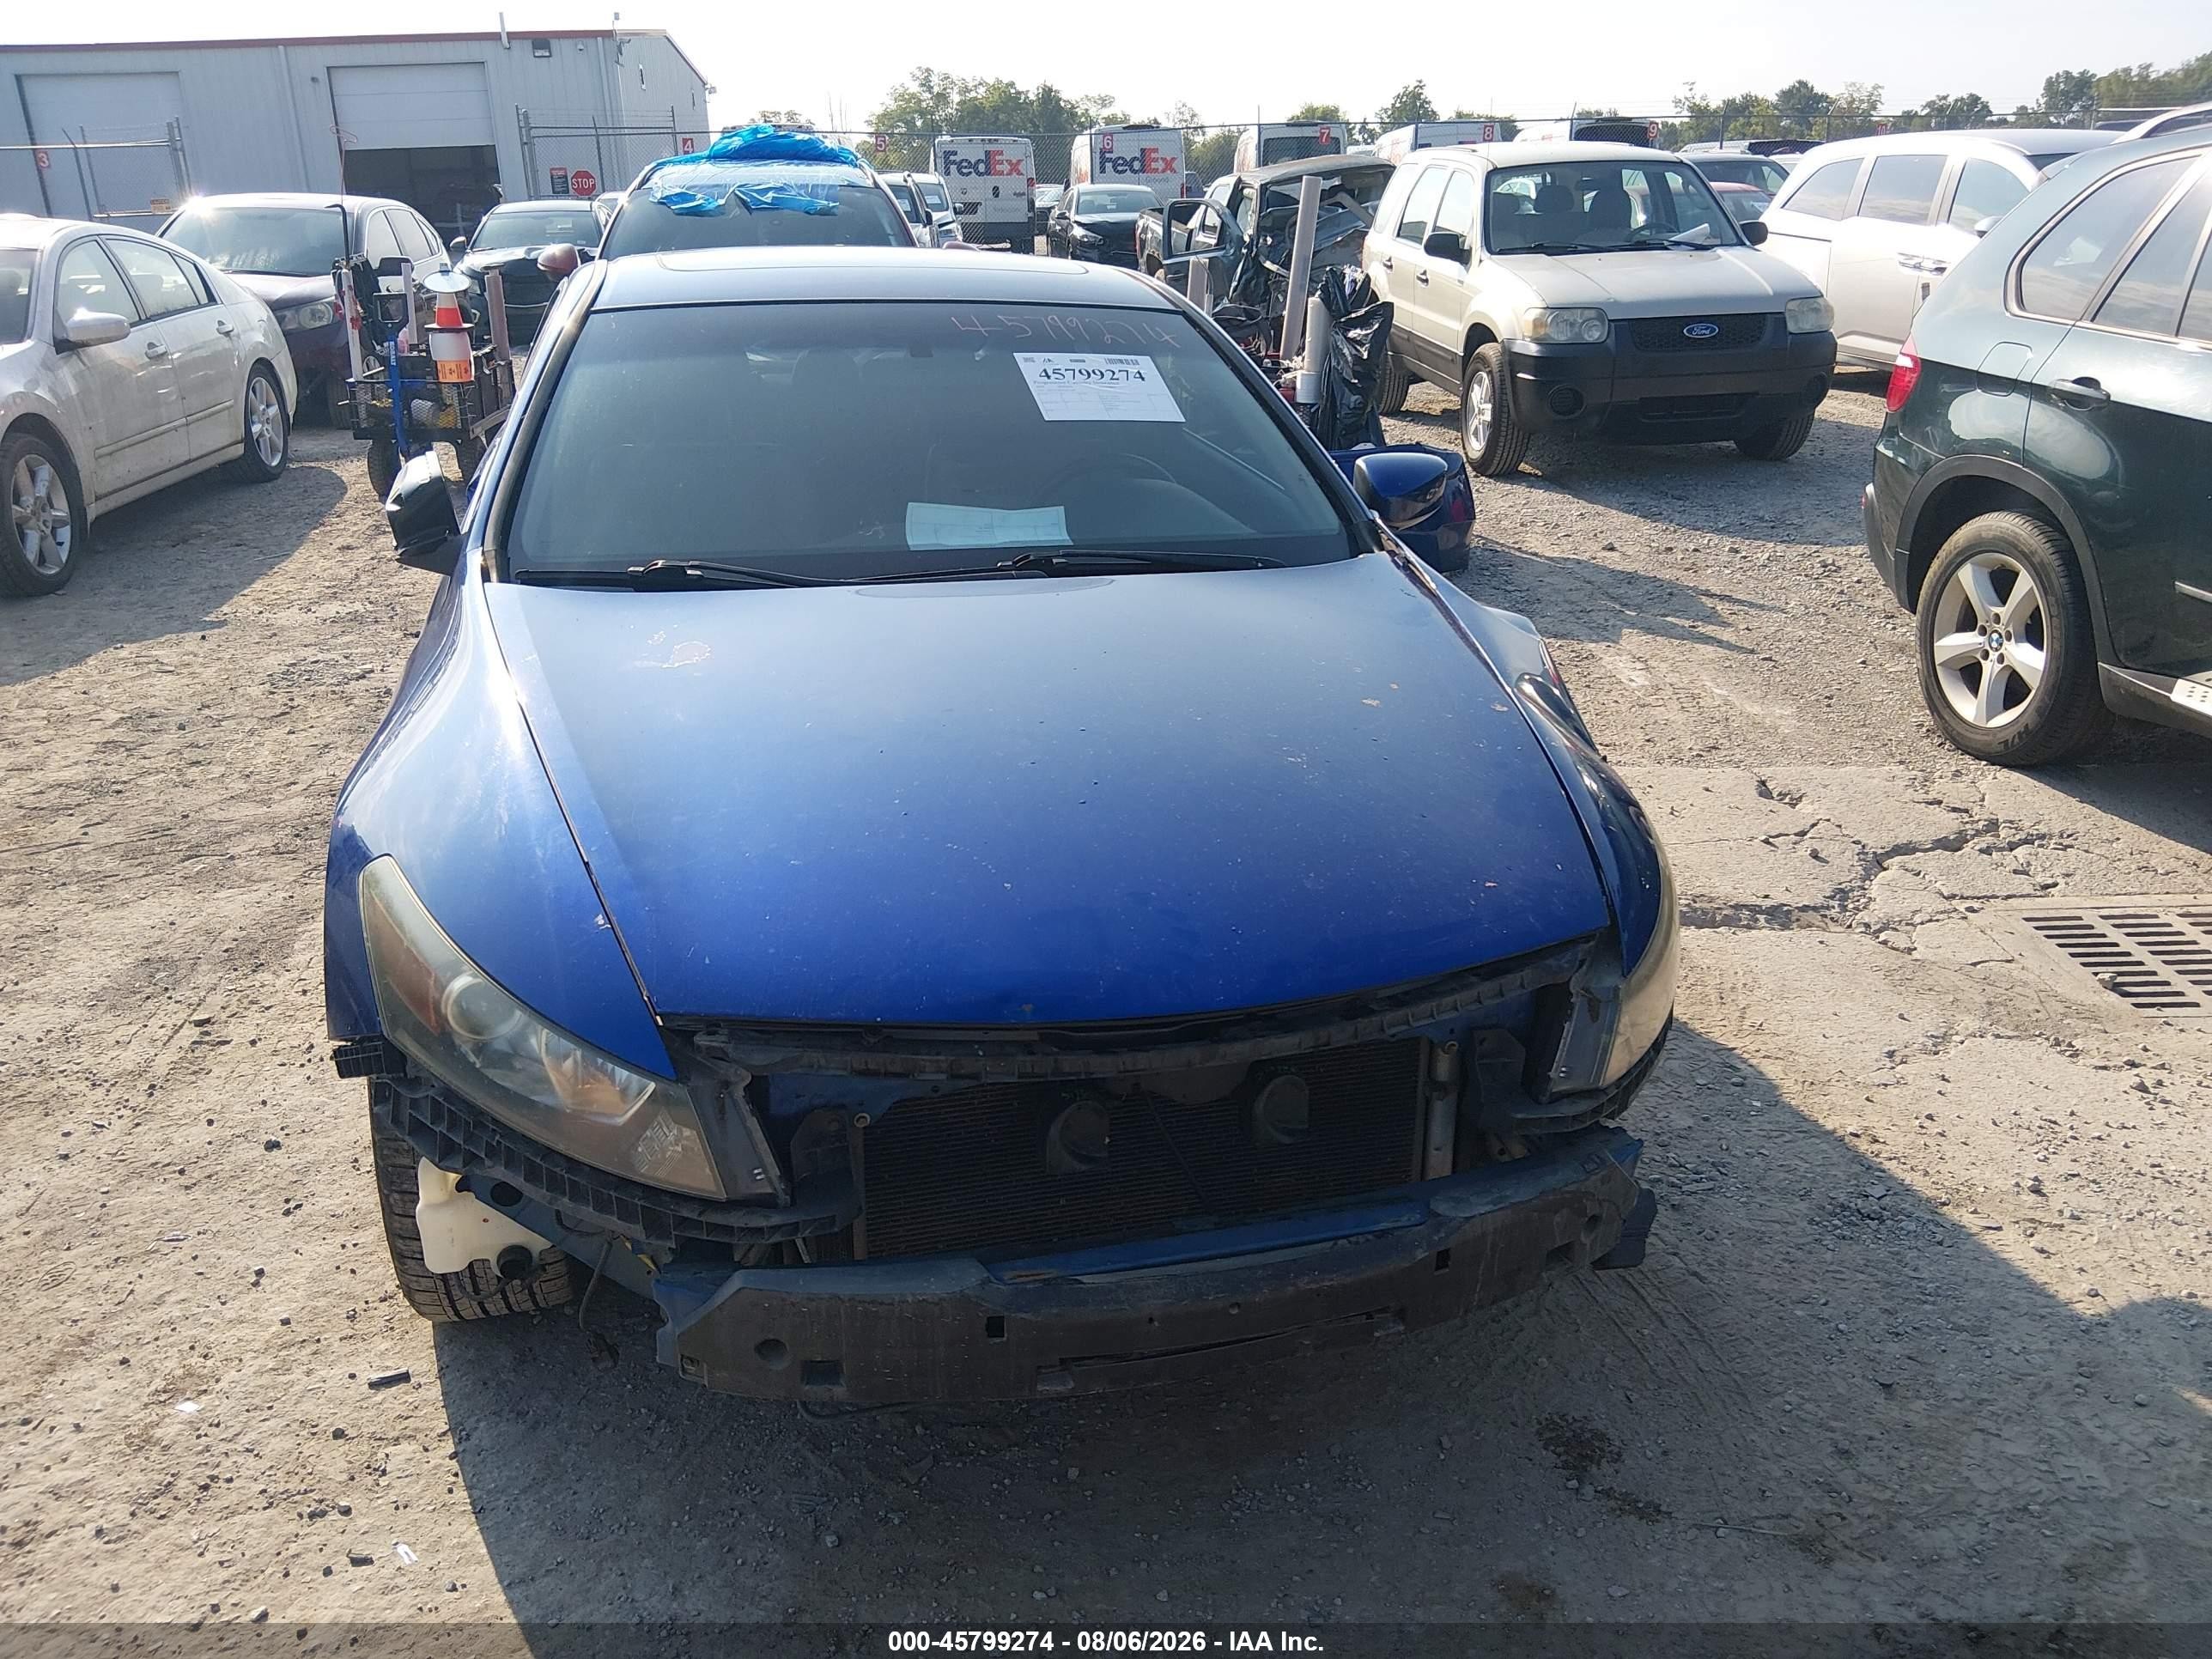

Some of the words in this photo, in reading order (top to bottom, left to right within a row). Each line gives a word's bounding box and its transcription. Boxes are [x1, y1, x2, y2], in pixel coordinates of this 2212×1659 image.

[1321, 129, 1329, 143] 7
[1484, 126, 1492, 140] 8
[1649, 124, 1657, 137] 9
[684, 139, 694, 154] 4
[876, 139, 885, 151] 5
[1103, 135, 1112, 149] 6
[38, 153, 49, 167] 3
[944, 149, 1024, 177] FedEx
[1099, 147, 1178, 174] FedEx
[572, 178, 595, 189] STOP
[1692, 325, 1711, 335] Ford
[1039, 368, 1146, 381] 45799274
